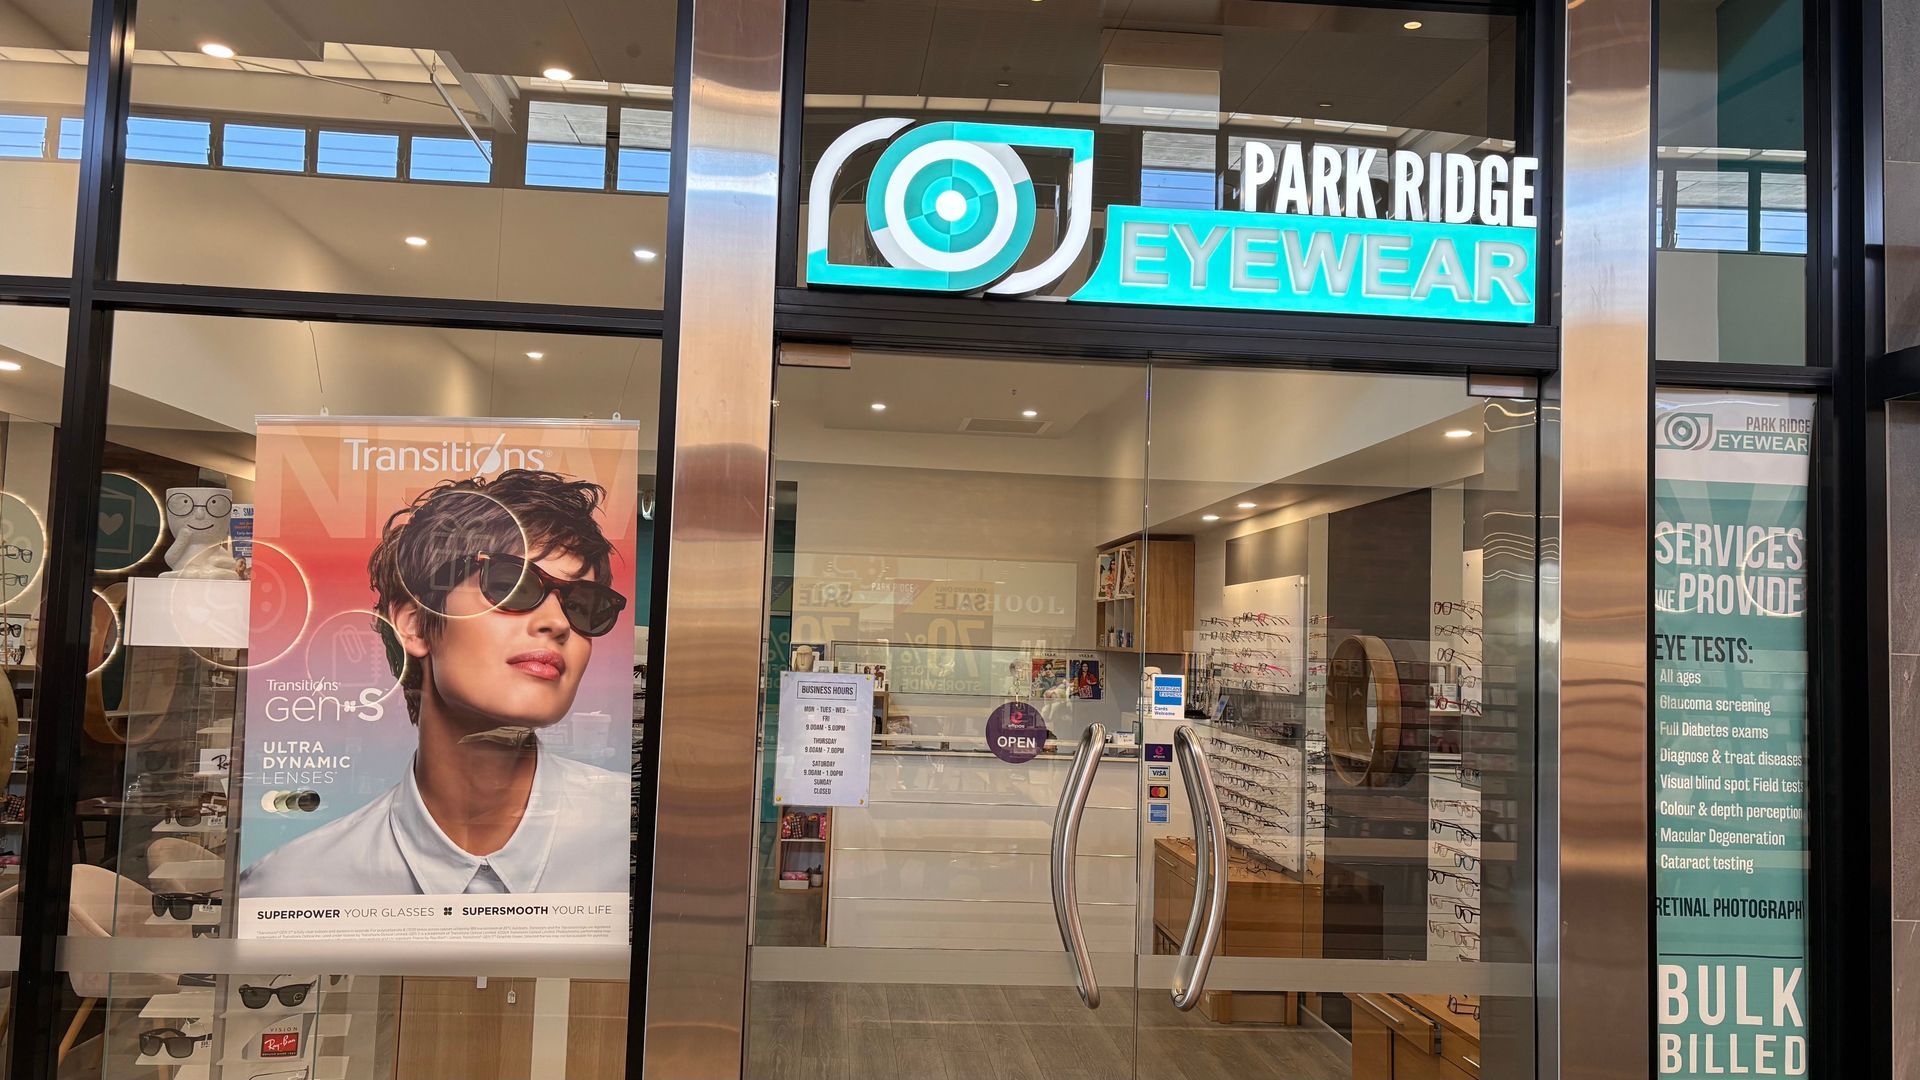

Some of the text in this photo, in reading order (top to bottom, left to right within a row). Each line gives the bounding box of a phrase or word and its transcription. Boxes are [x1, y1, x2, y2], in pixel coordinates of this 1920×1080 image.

[1243, 141, 1539, 228] PARK RIDGE
[1119, 221, 1532, 306] EYEWEAR
[1746, 416, 1811, 433] PARK RIDGE
[1718, 434, 1808, 452] EYEWEAR
[1655, 521, 1803, 570] SERVICES
[1655, 572, 1802, 618] WE PROVIDE
[1655, 634, 1754, 664] EYE TESTS:
[1660, 668, 1702, 687] All ages
[801, 685, 854, 696] BUSINESS HOURS
[804, 705, 815, 713] MON
[1660, 694, 1772, 716] Glaucoma screening
[1660, 721, 1769, 740] Full Diabetes exams
[263, 741, 324, 754] ULTRA
[804, 746, 823, 754] 9.00AM
[813, 737, 837, 745] THURSDAY
[996, 735, 1036, 749] OPEN
[263, 756, 351, 769] DYNAMIC
[812, 760, 836, 768] SATURDAY
[1660, 747, 1803, 767] Diagnose & treat diseases
[262, 771, 335, 785] LENSES
[813, 778, 832, 786] SUNDAY
[1660, 773, 1694, 790] Visual
[1695, 775, 1721, 791] blind
[1724, 777, 1751, 794] spot
[1753, 777, 1779, 793] Field
[813, 787, 832, 795] CLOSED
[1660, 800, 1803, 823] Colour & depth perception
[1660, 827, 1786, 847] Macular Degeneration
[1660, 853, 1754, 875] Cataract testing
[257, 905, 612, 921] SUPERPOWER YOUR GLASSES SUPERSMOOTH YOUR LIFE
[1656, 897, 1710, 918] RETINAL
[1657, 963, 1804, 1028] BULK
[1659, 1033, 1807, 1076] BILLED
